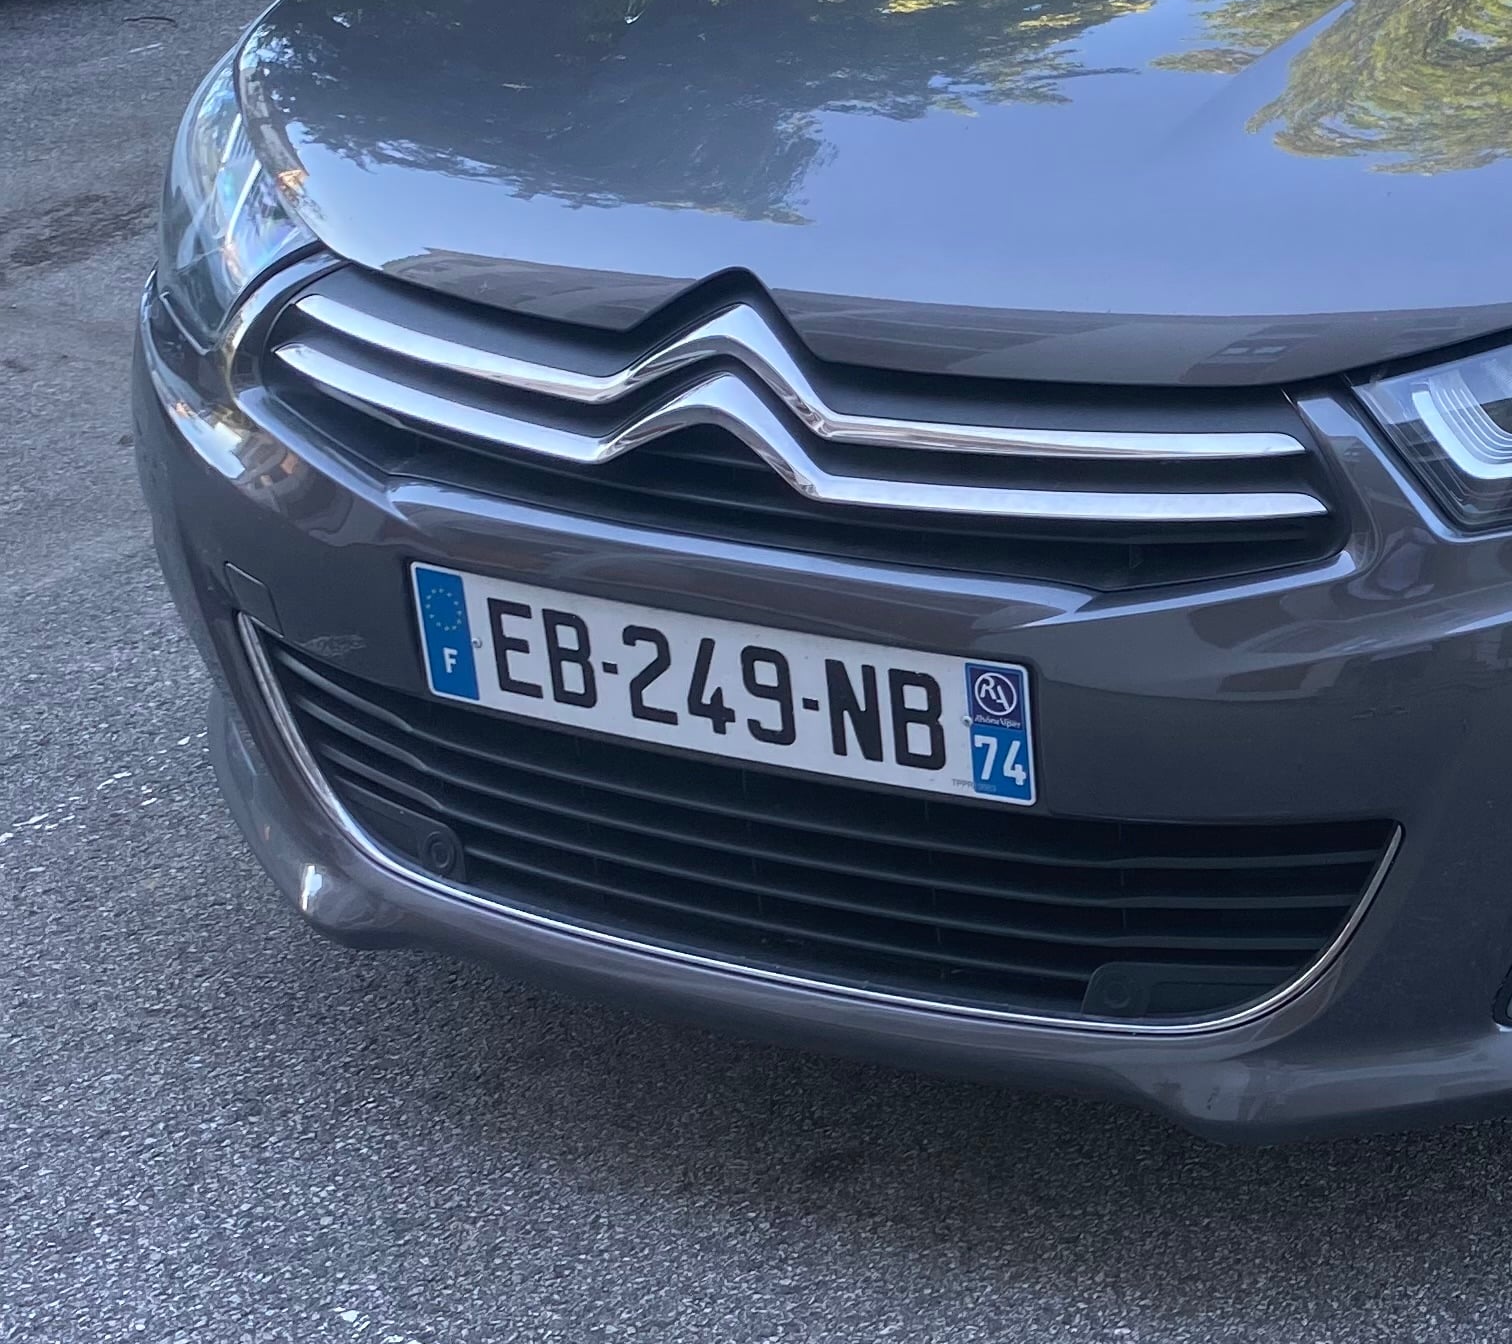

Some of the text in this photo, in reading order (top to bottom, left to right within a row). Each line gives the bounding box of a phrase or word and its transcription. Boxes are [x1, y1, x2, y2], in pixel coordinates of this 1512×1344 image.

[443, 647, 457, 673] F
[487, 598, 946, 770] EB-249-NB
[974, 734, 1026, 786] 74
